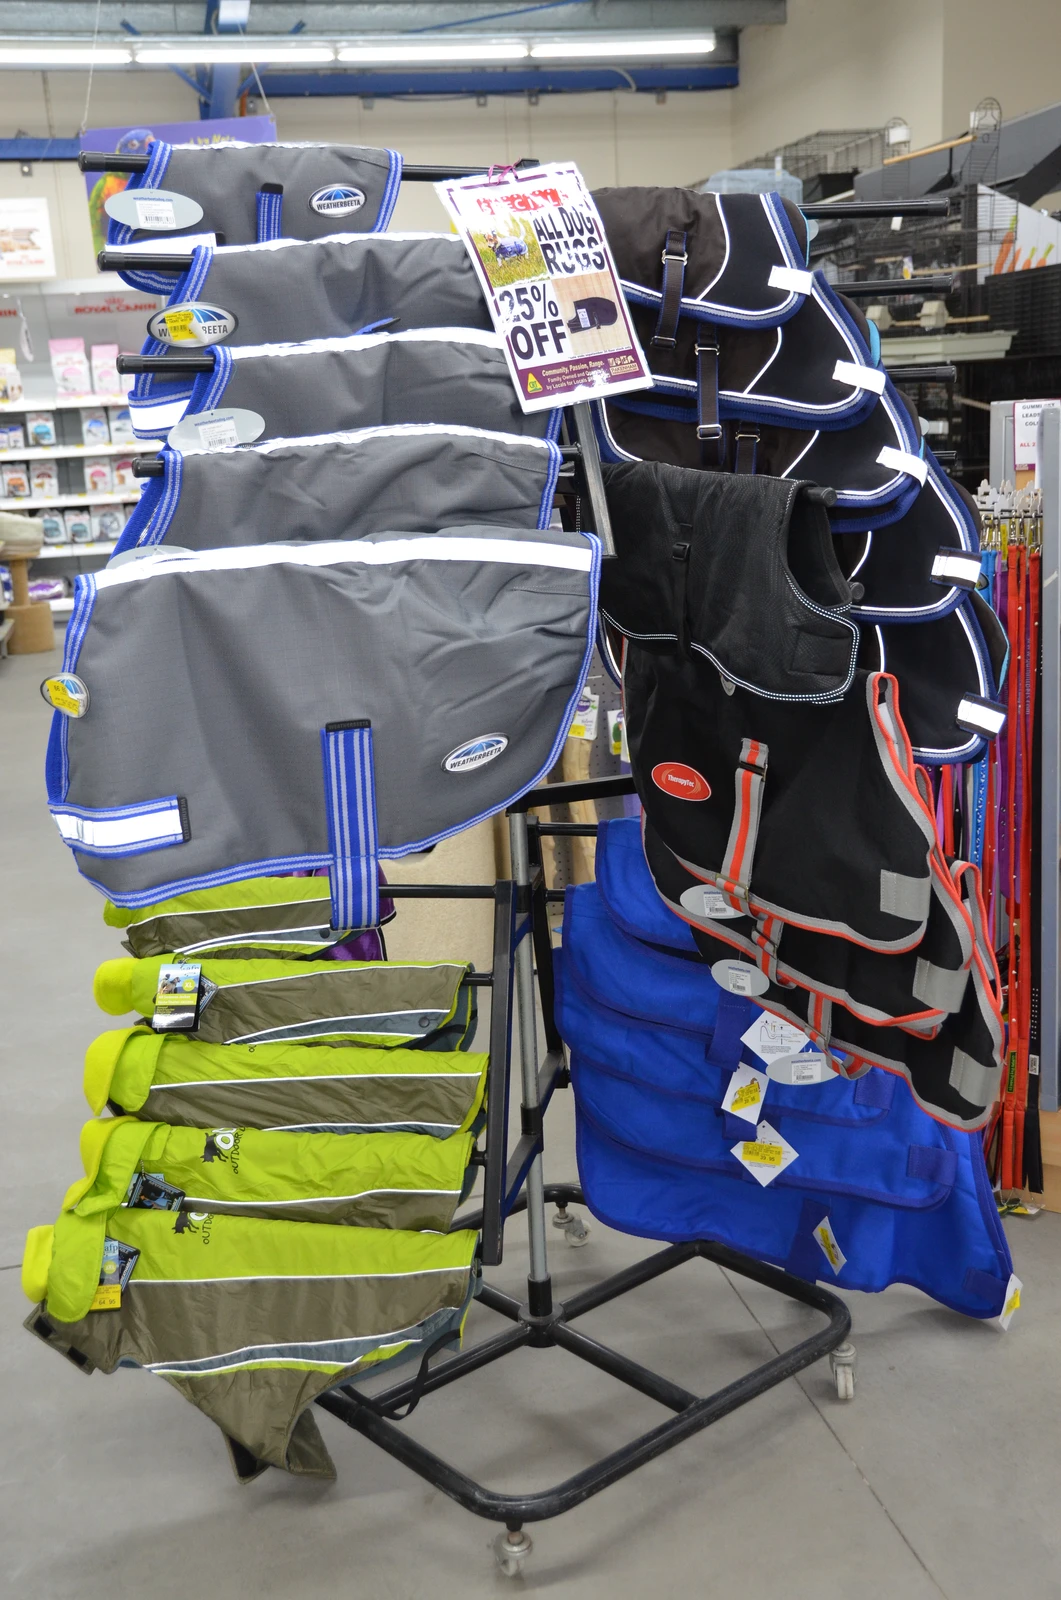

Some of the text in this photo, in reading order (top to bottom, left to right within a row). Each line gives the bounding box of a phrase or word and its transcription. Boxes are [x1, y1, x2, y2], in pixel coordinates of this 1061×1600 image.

[316, 199, 361, 211] WEATHERBEETA
[533, 205, 595, 241] ALL DOG
[540, 236, 605, 274] RUGS
[74, 303, 157, 314] ROYAL CANIN
[498, 283, 559, 322] 25%
[510, 319, 567, 360] OFF
[541, 360, 605, 377] Community, Passion, Range.
[547, 375, 562, 383] Family
[562, 372, 577, 381] Owned
[552, 381, 566, 389] Locals
[573, 378, 588, 386] Locals
[450, 746, 502, 769] WEATHERBEETA
[667, 774, 695, 787] TherapyTec
[202, 1213, 214, 1245] OUTDO
[104, 1243, 118, 1253] afp
